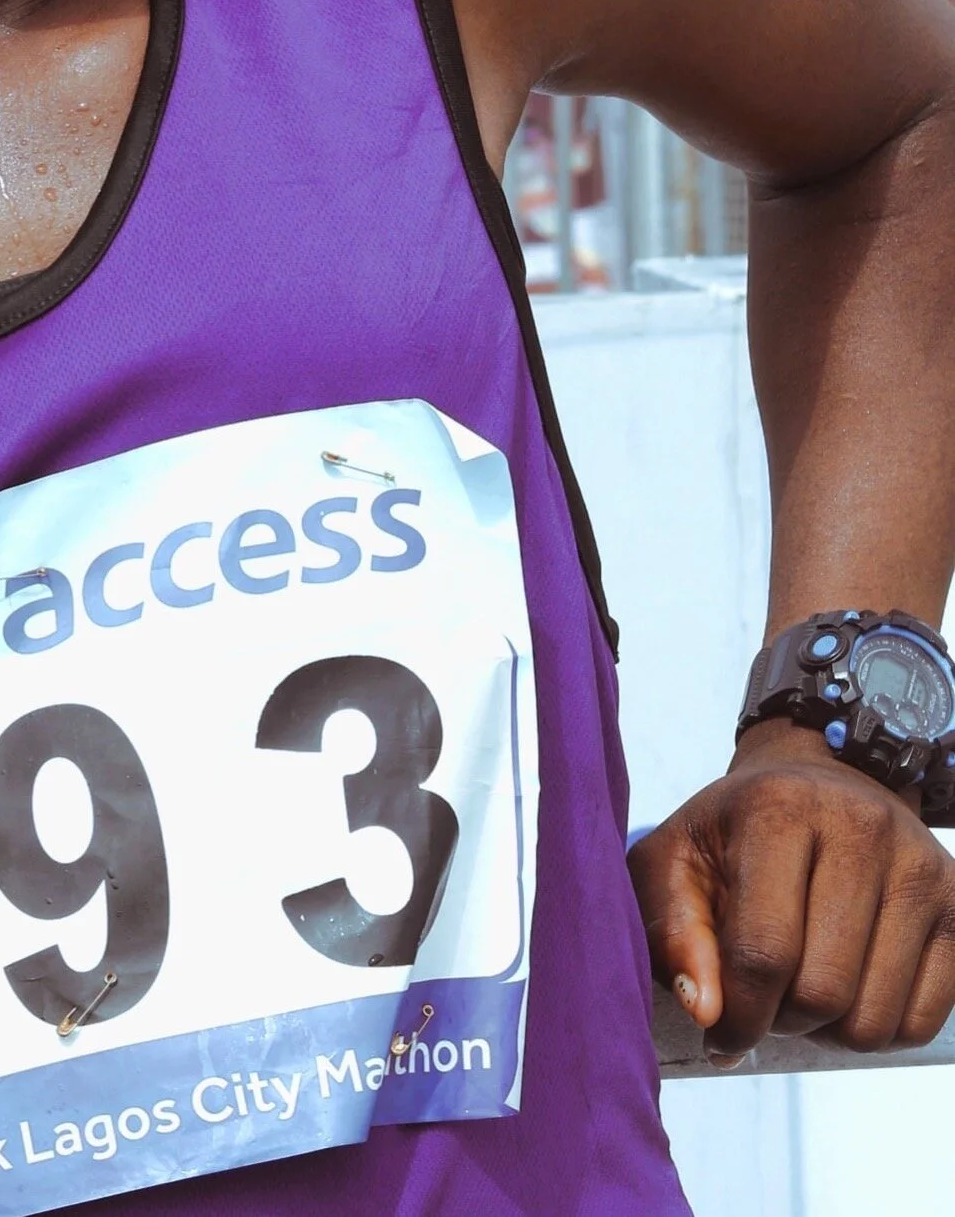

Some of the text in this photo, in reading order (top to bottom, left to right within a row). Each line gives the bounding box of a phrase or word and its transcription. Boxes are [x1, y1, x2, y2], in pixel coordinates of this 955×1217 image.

[2, 488, 428, 655] access
[20, 1099, 181, 1161] Lagos
[191, 1072, 302, 1123] City
